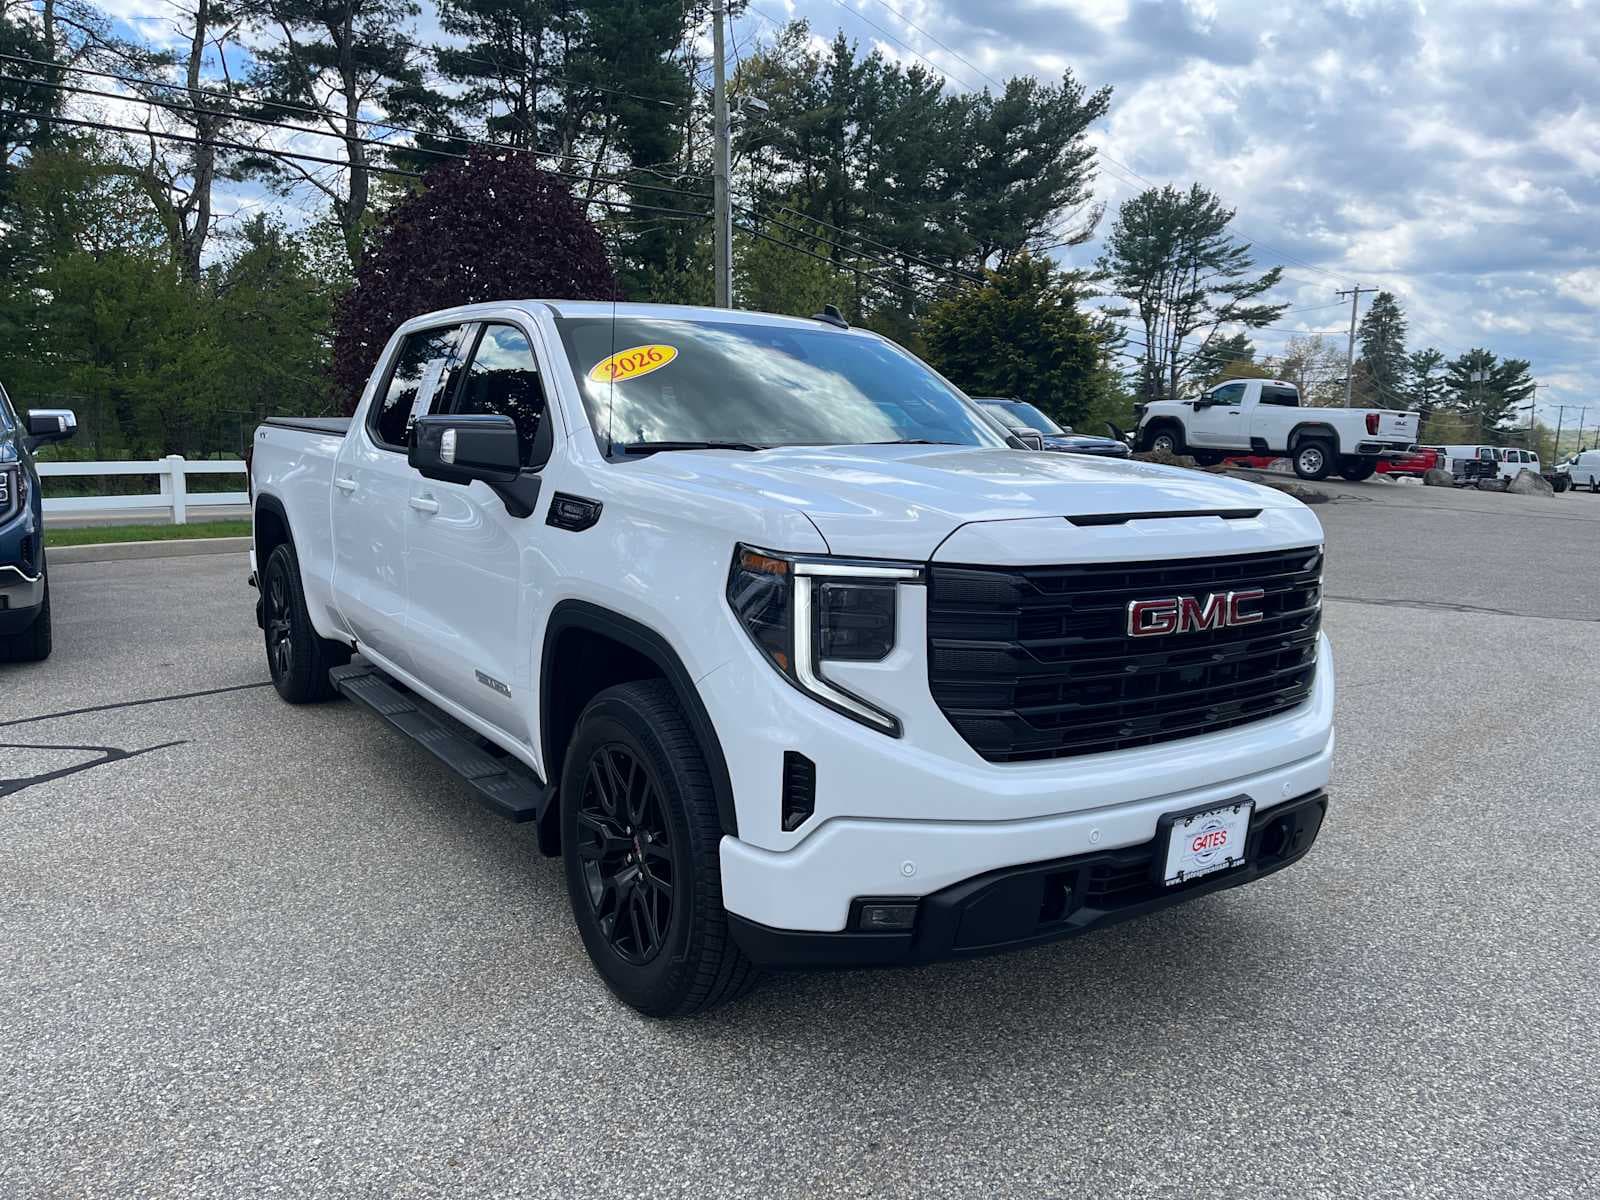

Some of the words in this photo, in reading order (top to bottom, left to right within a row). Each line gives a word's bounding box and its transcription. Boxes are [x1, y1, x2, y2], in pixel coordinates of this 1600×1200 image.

[604, 347, 663, 378] 2026
[1127, 589, 1265, 637] GMC
[1192, 830, 1228, 852] GATES
